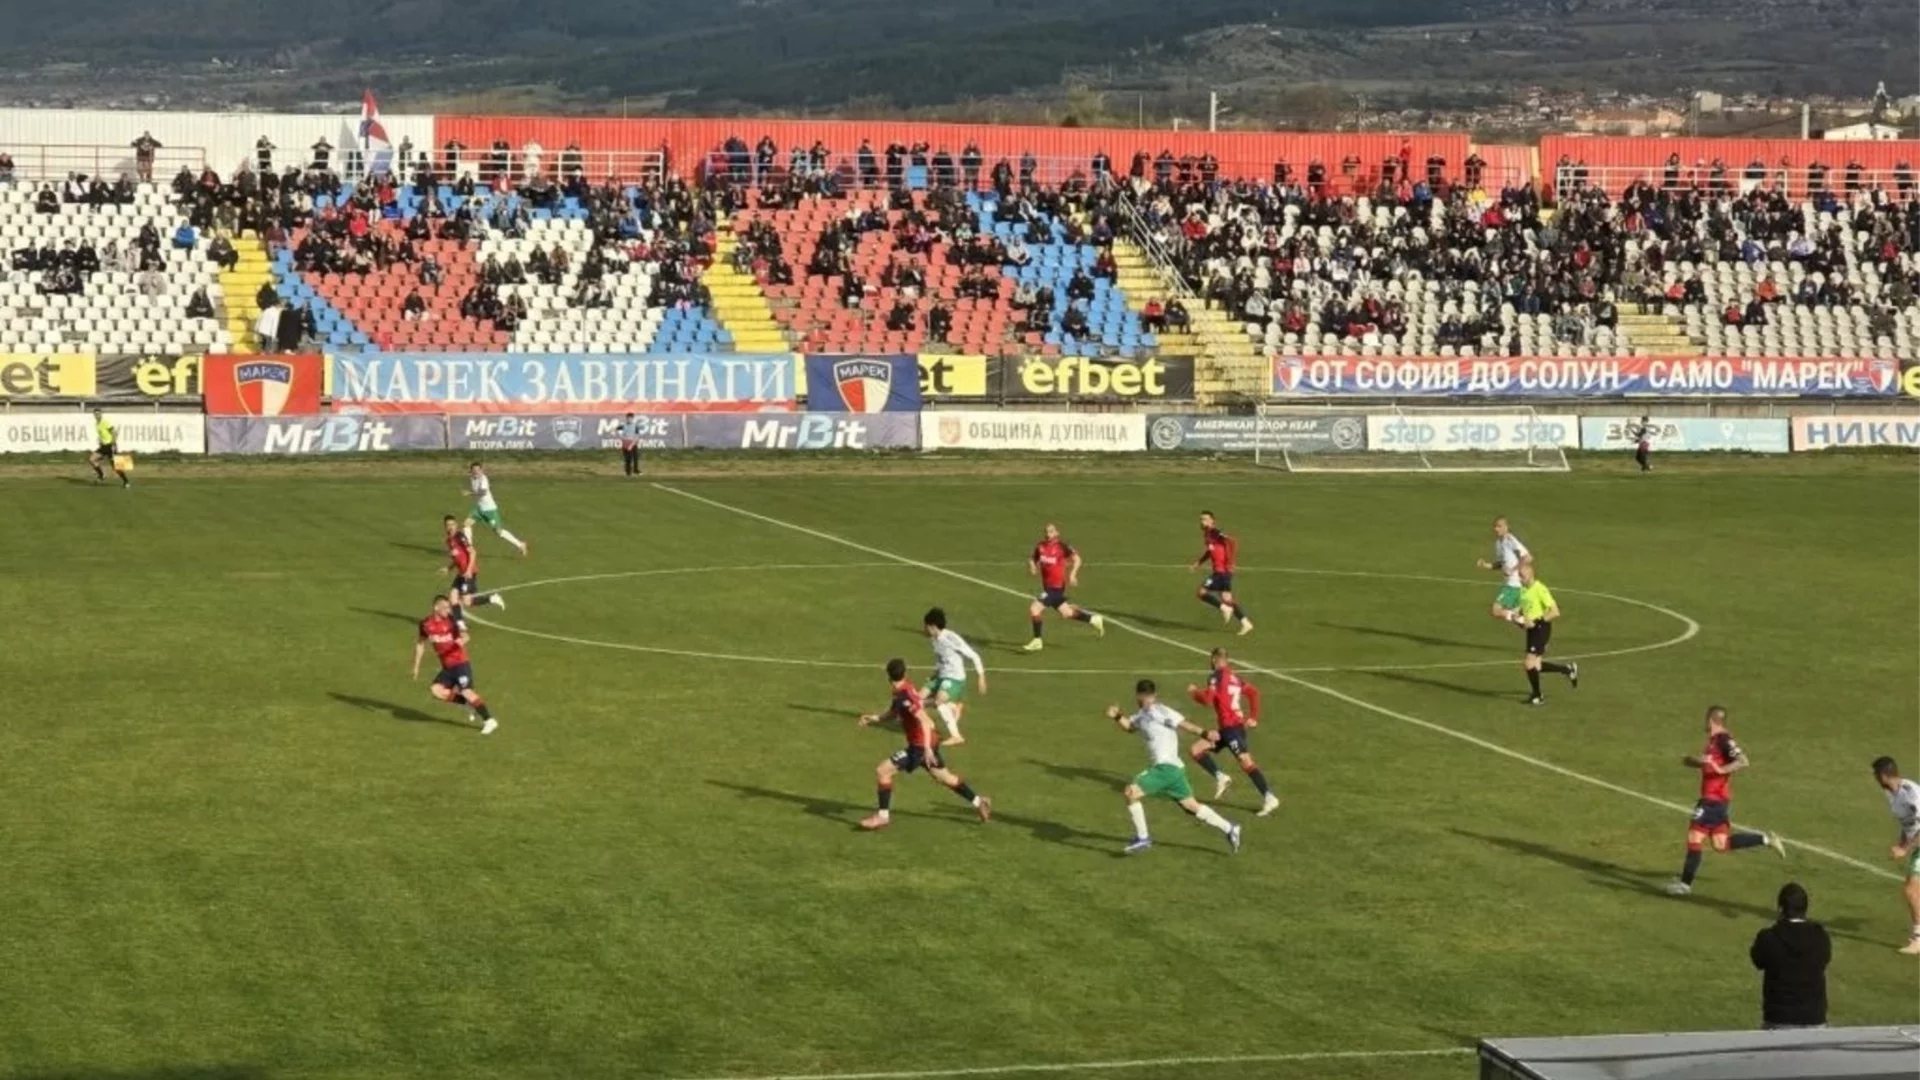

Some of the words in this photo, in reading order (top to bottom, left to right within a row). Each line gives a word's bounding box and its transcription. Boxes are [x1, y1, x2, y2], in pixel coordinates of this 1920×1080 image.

[341, 359, 510, 404] МАРЕК
[520, 359, 789, 403] ЗАВИНАГИ
[839, 364, 887, 379] МАРЕК
[1020, 356, 1165, 396] efbet
[1309, 360, 1348, 389] ОТ
[1355, 360, 1459, 390] СОФИЯ
[1468, 360, 1511, 391] ДО
[1519, 360, 1620, 389] СОЛУН
[1649, 360, 1733, 389] САМО
[1742, 360, 1864, 390] "МАРЕК"
[8, 425, 88, 444] ОБЩИНА
[264, 414, 393, 453] MrBit
[465, 416, 538, 437] MrBit
[741, 414, 867, 449] MrBit
[969, 422, 1043, 441] ОБЩИНА
[1050, 423, 1128, 442] ДУПНИЦА
